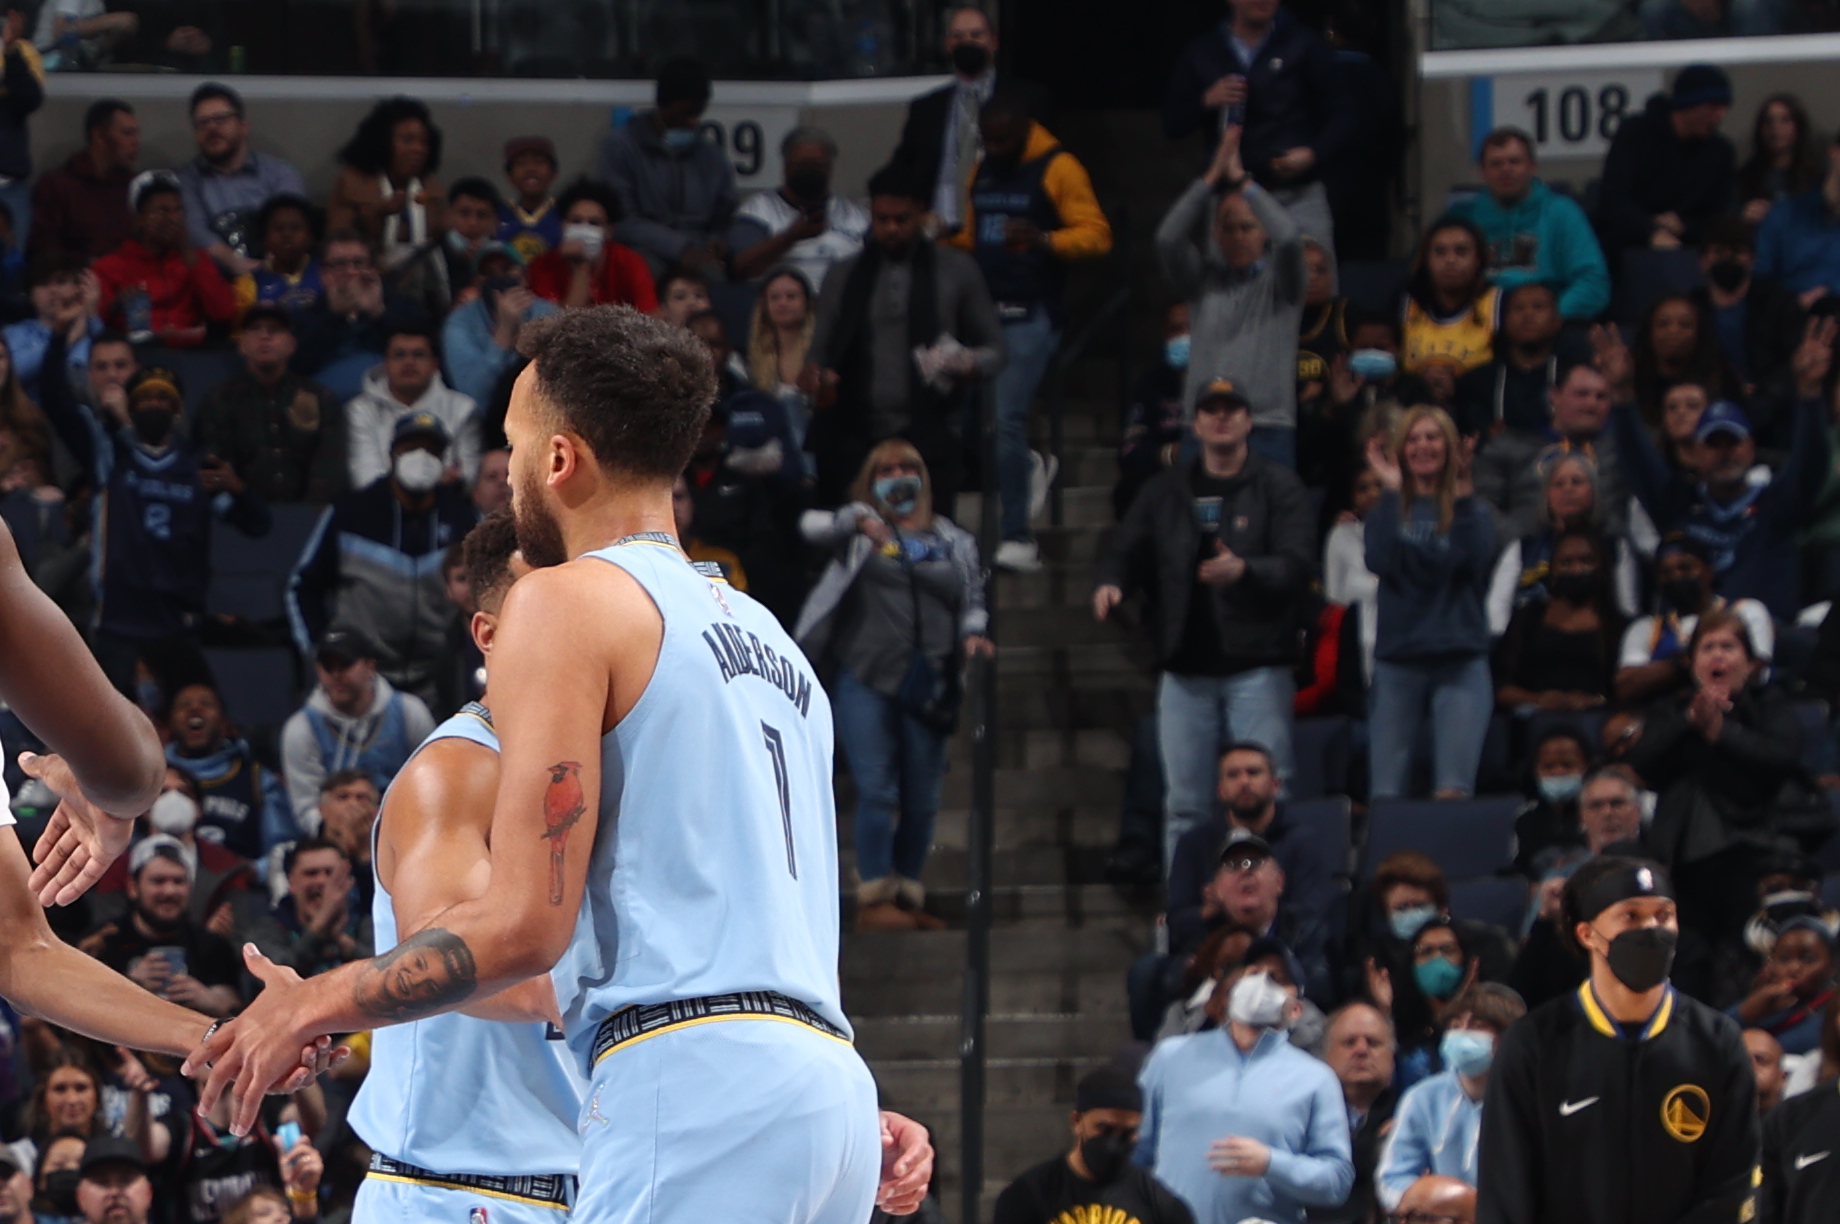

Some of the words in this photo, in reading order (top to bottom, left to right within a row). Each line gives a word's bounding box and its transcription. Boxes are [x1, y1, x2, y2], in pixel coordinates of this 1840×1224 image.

[1525, 84, 1628, 143] 108
[701, 622, 812, 720] ANDERSON
[760, 718, 798, 881] 1
